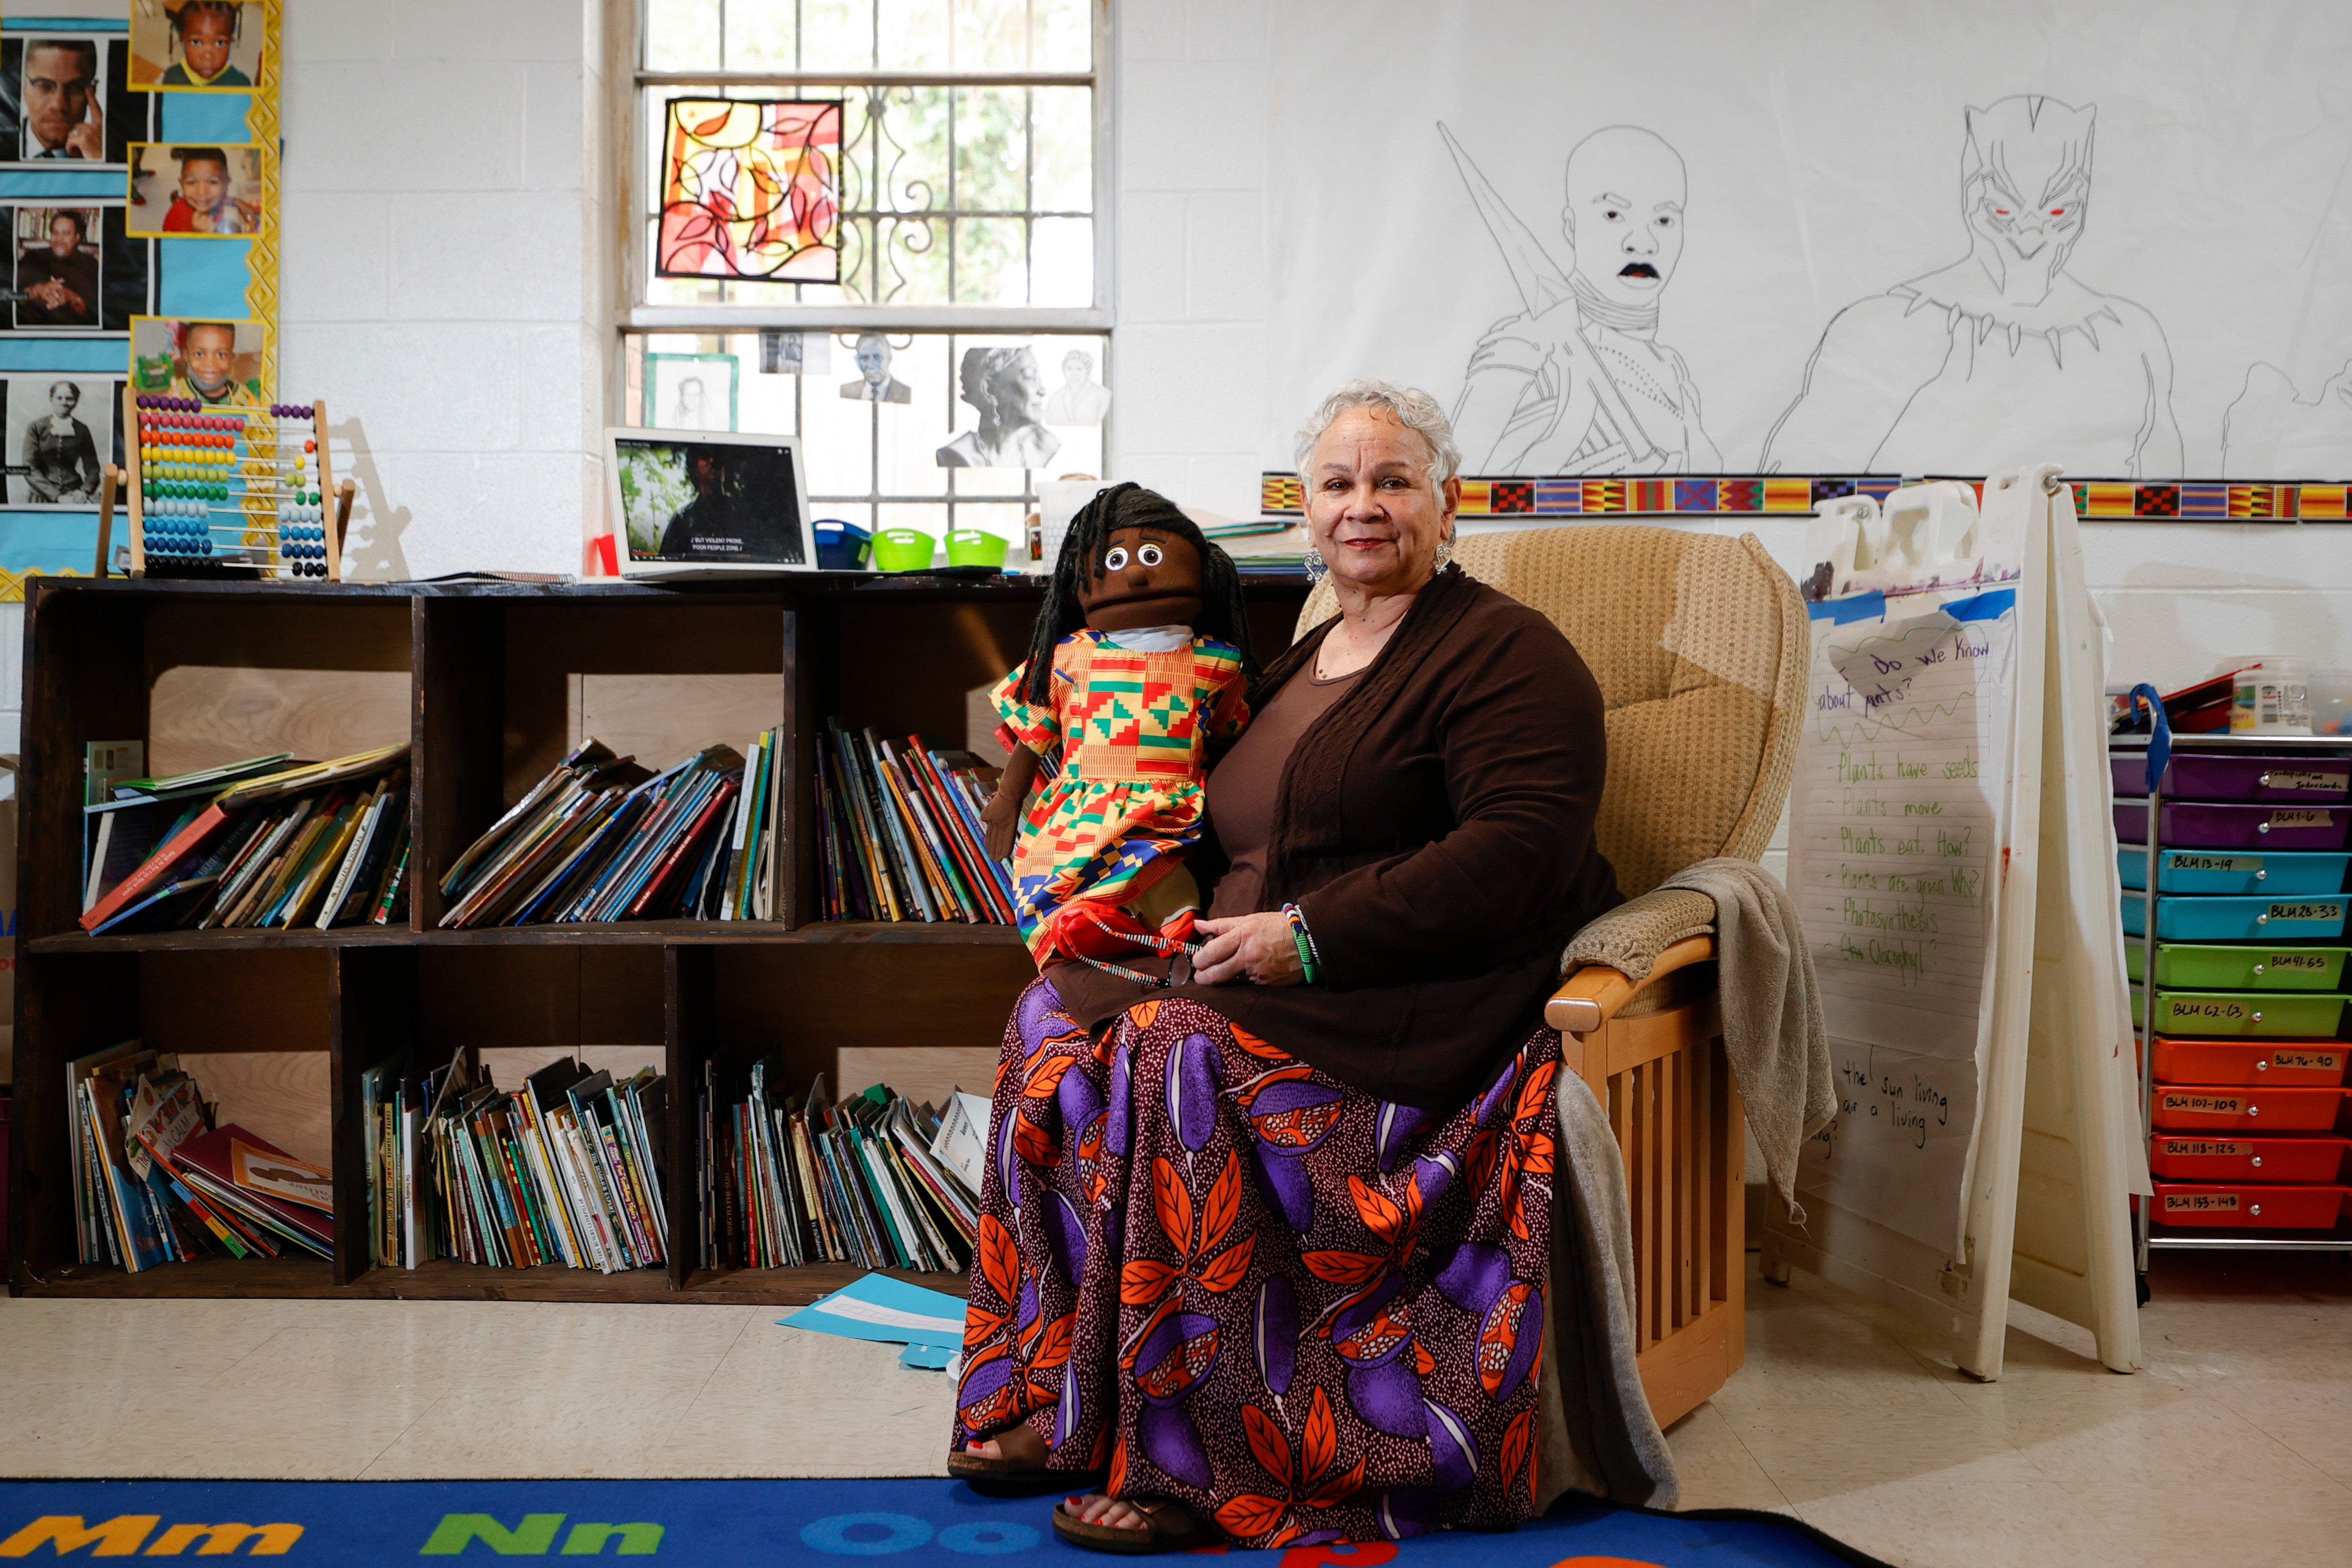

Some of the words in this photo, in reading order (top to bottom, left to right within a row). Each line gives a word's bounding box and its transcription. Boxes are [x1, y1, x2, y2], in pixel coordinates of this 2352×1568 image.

[1819, 685, 1854, 711] about
[1838, 750, 1883, 784] Plants
[1897, 752, 1927, 778] have
[1943, 745, 1977, 780] seeds
[1843, 787, 1886, 816] Plants
[1904, 802, 1943, 816] move
[959, 799, 968, 810] THE
[965, 810, 977, 826] MOON
[974, 825, 984, 839] RING
[2276, 812, 2294, 822] BLM
[344, 834, 364, 863] MANSA
[1841, 826, 1885, 856] Plants
[2175, 855, 2199, 868] BLM
[333, 866, 350, 888] MUSA
[1888, 876, 1909, 891] are
[2271, 905, 2296, 918] BLM
[2271, 956, 2291, 967] BLM
[2174, 1003, 2199, 1016] BLM
[2276, 1054, 2293, 1065] BLM
[1843, 1059, 1867, 1085] the
[1915, 1074, 1948, 1126] living
[2167, 1097, 2188, 1107] BLM
[1871, 1105, 1878, 1116] a
[1892, 1100, 1926, 1150] living
[2168, 1142, 2188, 1153] BLM
[624, 1151, 633, 1166] EARLY
[615, 1165, 624, 1177] Five
[628, 1166, 638, 1184] SUNDAY
[590, 1152, 598, 1165] THE
[594, 1165, 608, 1191] DINOSAUR
[603, 1192, 615, 1214] EXPERT
[617, 1177, 632, 1202] Tumbling
[633, 1184, 645, 1206] MORNING
[2167, 1197, 2189, 1208] BLM
[576, 1197, 594, 1229] CATERPILLAR
[627, 1202, 637, 1220] Tigers
[726, 1205, 732, 1217] TO
[633, 1221, 645, 1244] CATERPILLAR
[960, 1219, 969, 1228] Day
[588, 1228, 600, 1247] HUNGRY
[595, 1247, 604, 1259] VERY
[0, 1514, 305, 1557] Mm
[419, 1512, 665, 1555] Nn
[800, 1511, 1041, 1554] Oo
